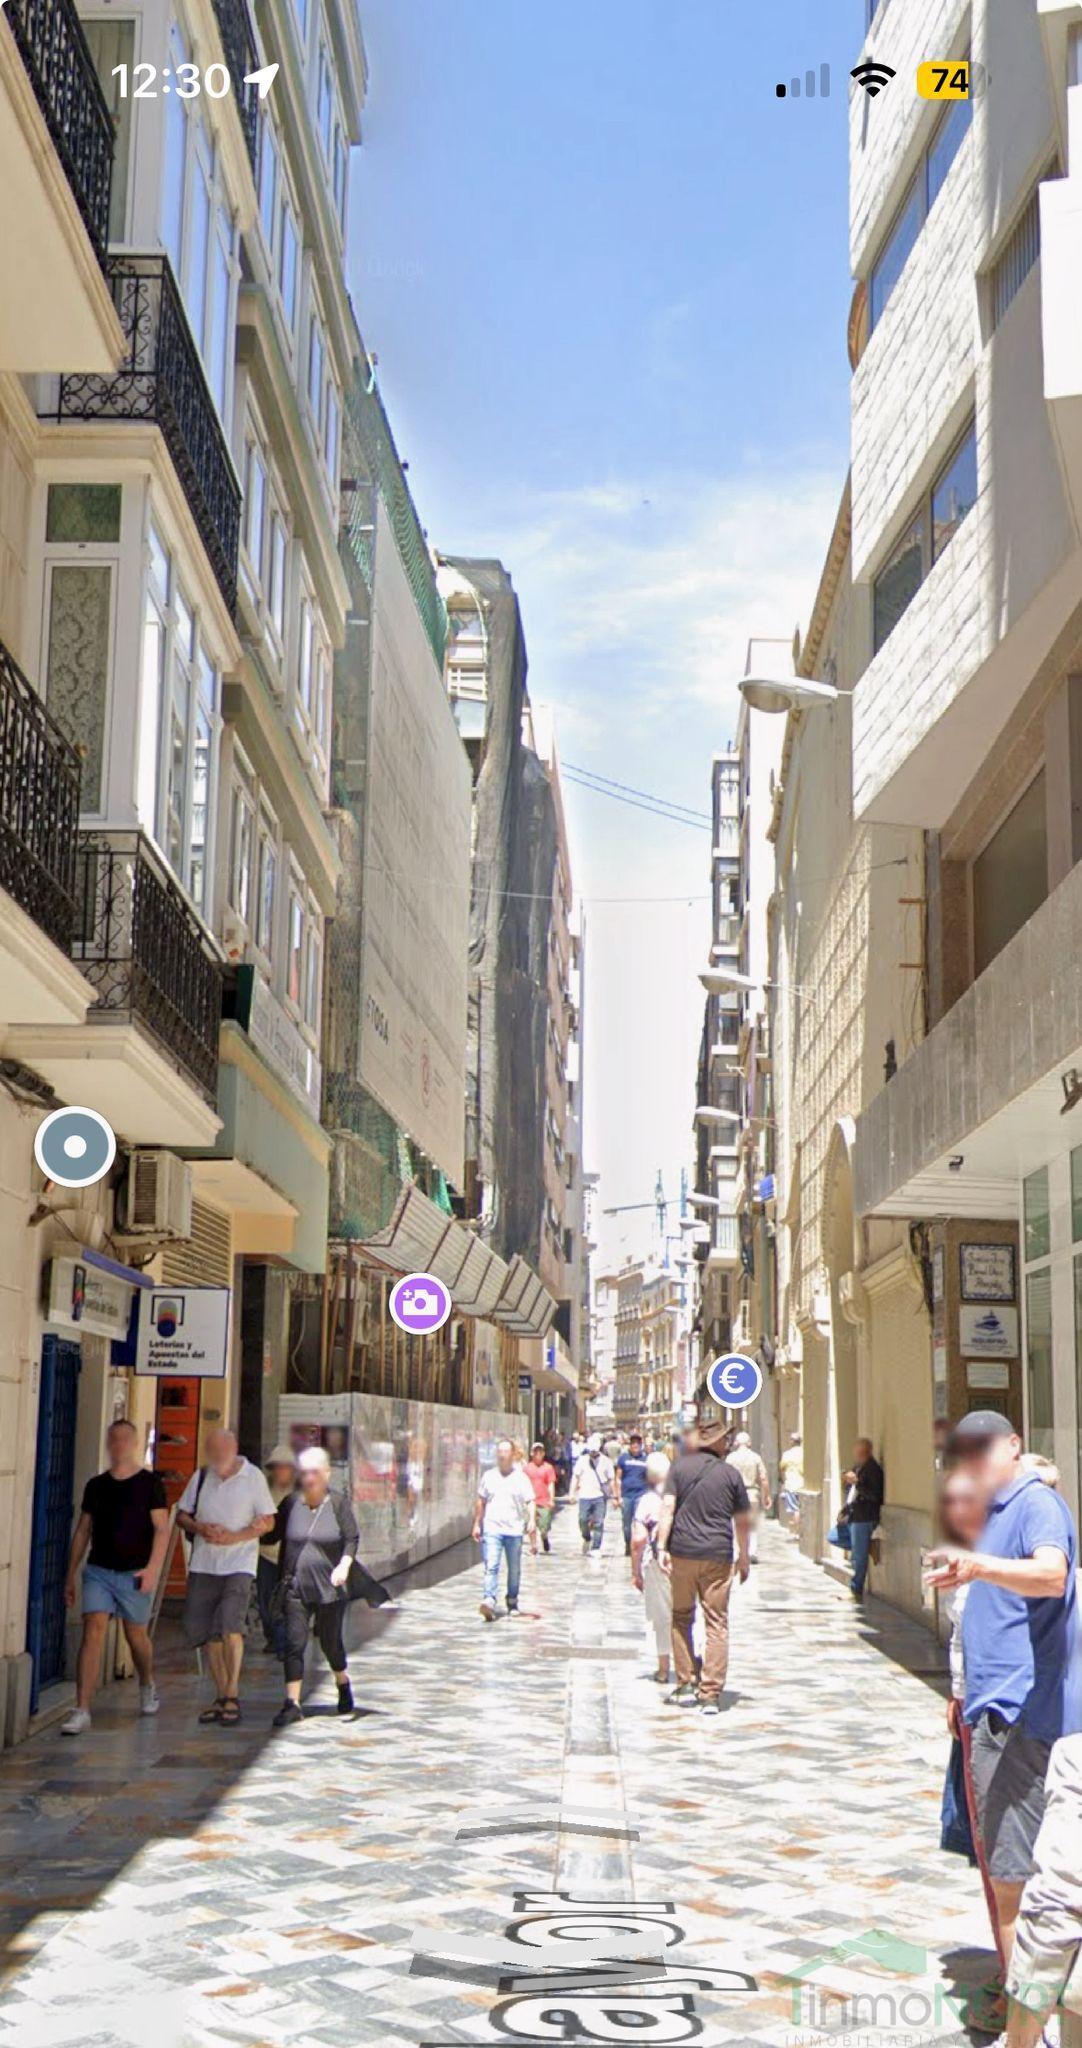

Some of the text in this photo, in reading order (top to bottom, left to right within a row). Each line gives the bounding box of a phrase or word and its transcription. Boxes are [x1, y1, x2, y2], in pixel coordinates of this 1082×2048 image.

[149, 1350, 205, 1359] Apuestas del
[148, 1360, 178, 1368] Estado
